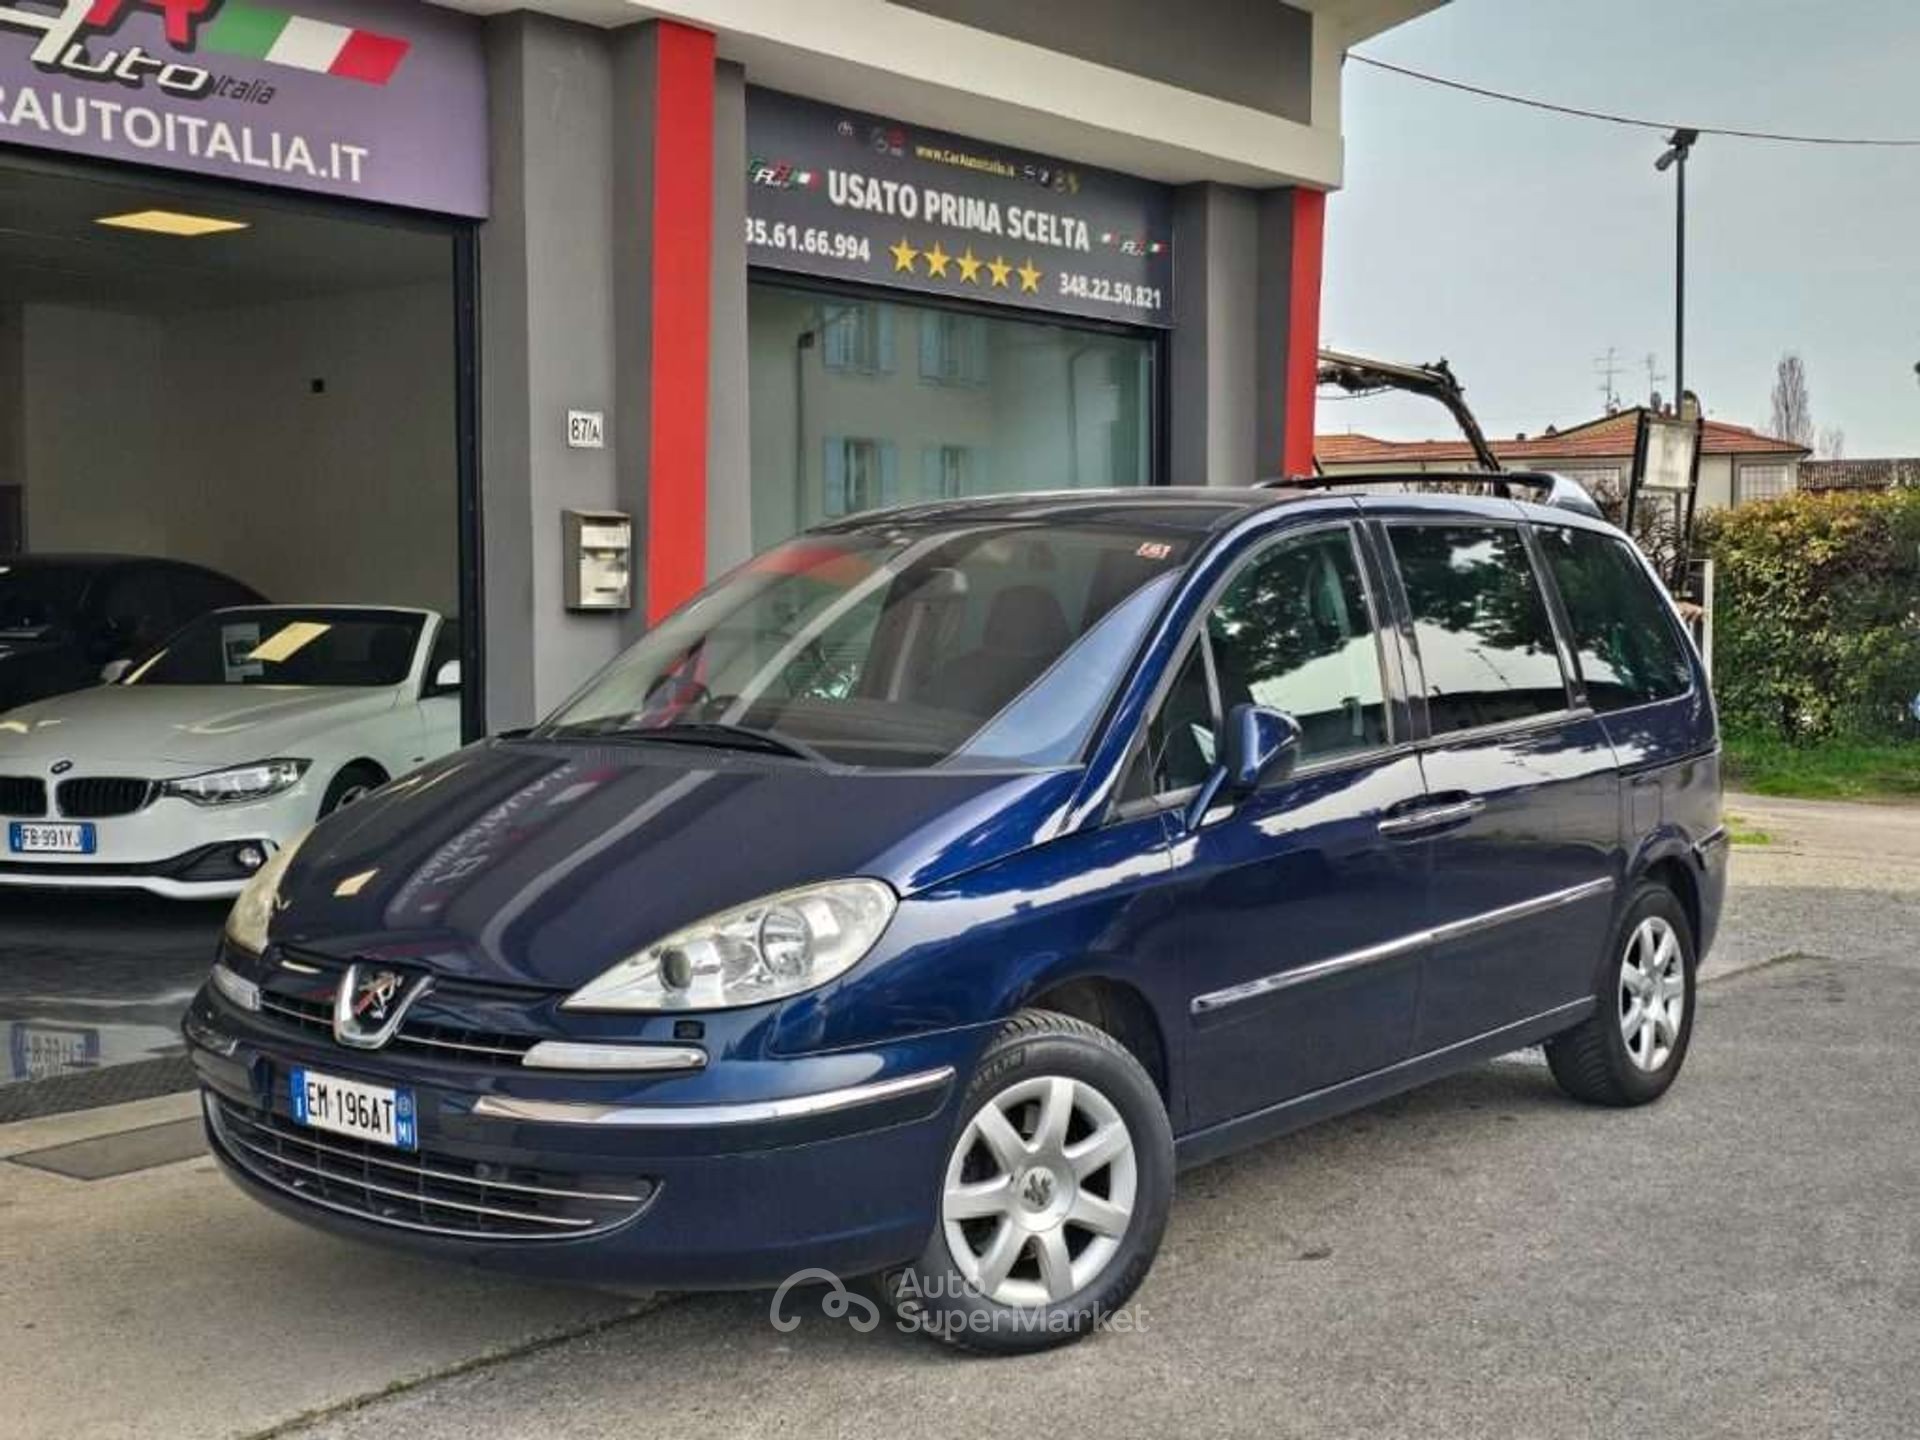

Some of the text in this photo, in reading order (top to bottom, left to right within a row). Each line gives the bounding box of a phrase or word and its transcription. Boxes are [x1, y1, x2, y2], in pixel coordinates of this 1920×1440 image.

[828, 169, 919, 219] USATO
[924, 189, 1001, 236] PRIMA
[1007, 206, 1090, 252] SCELTA
[1059, 272, 1162, 310] 348.22.50.821
[307, 1082, 329, 1119] EM
[336, 1089, 393, 1135] 196AT
